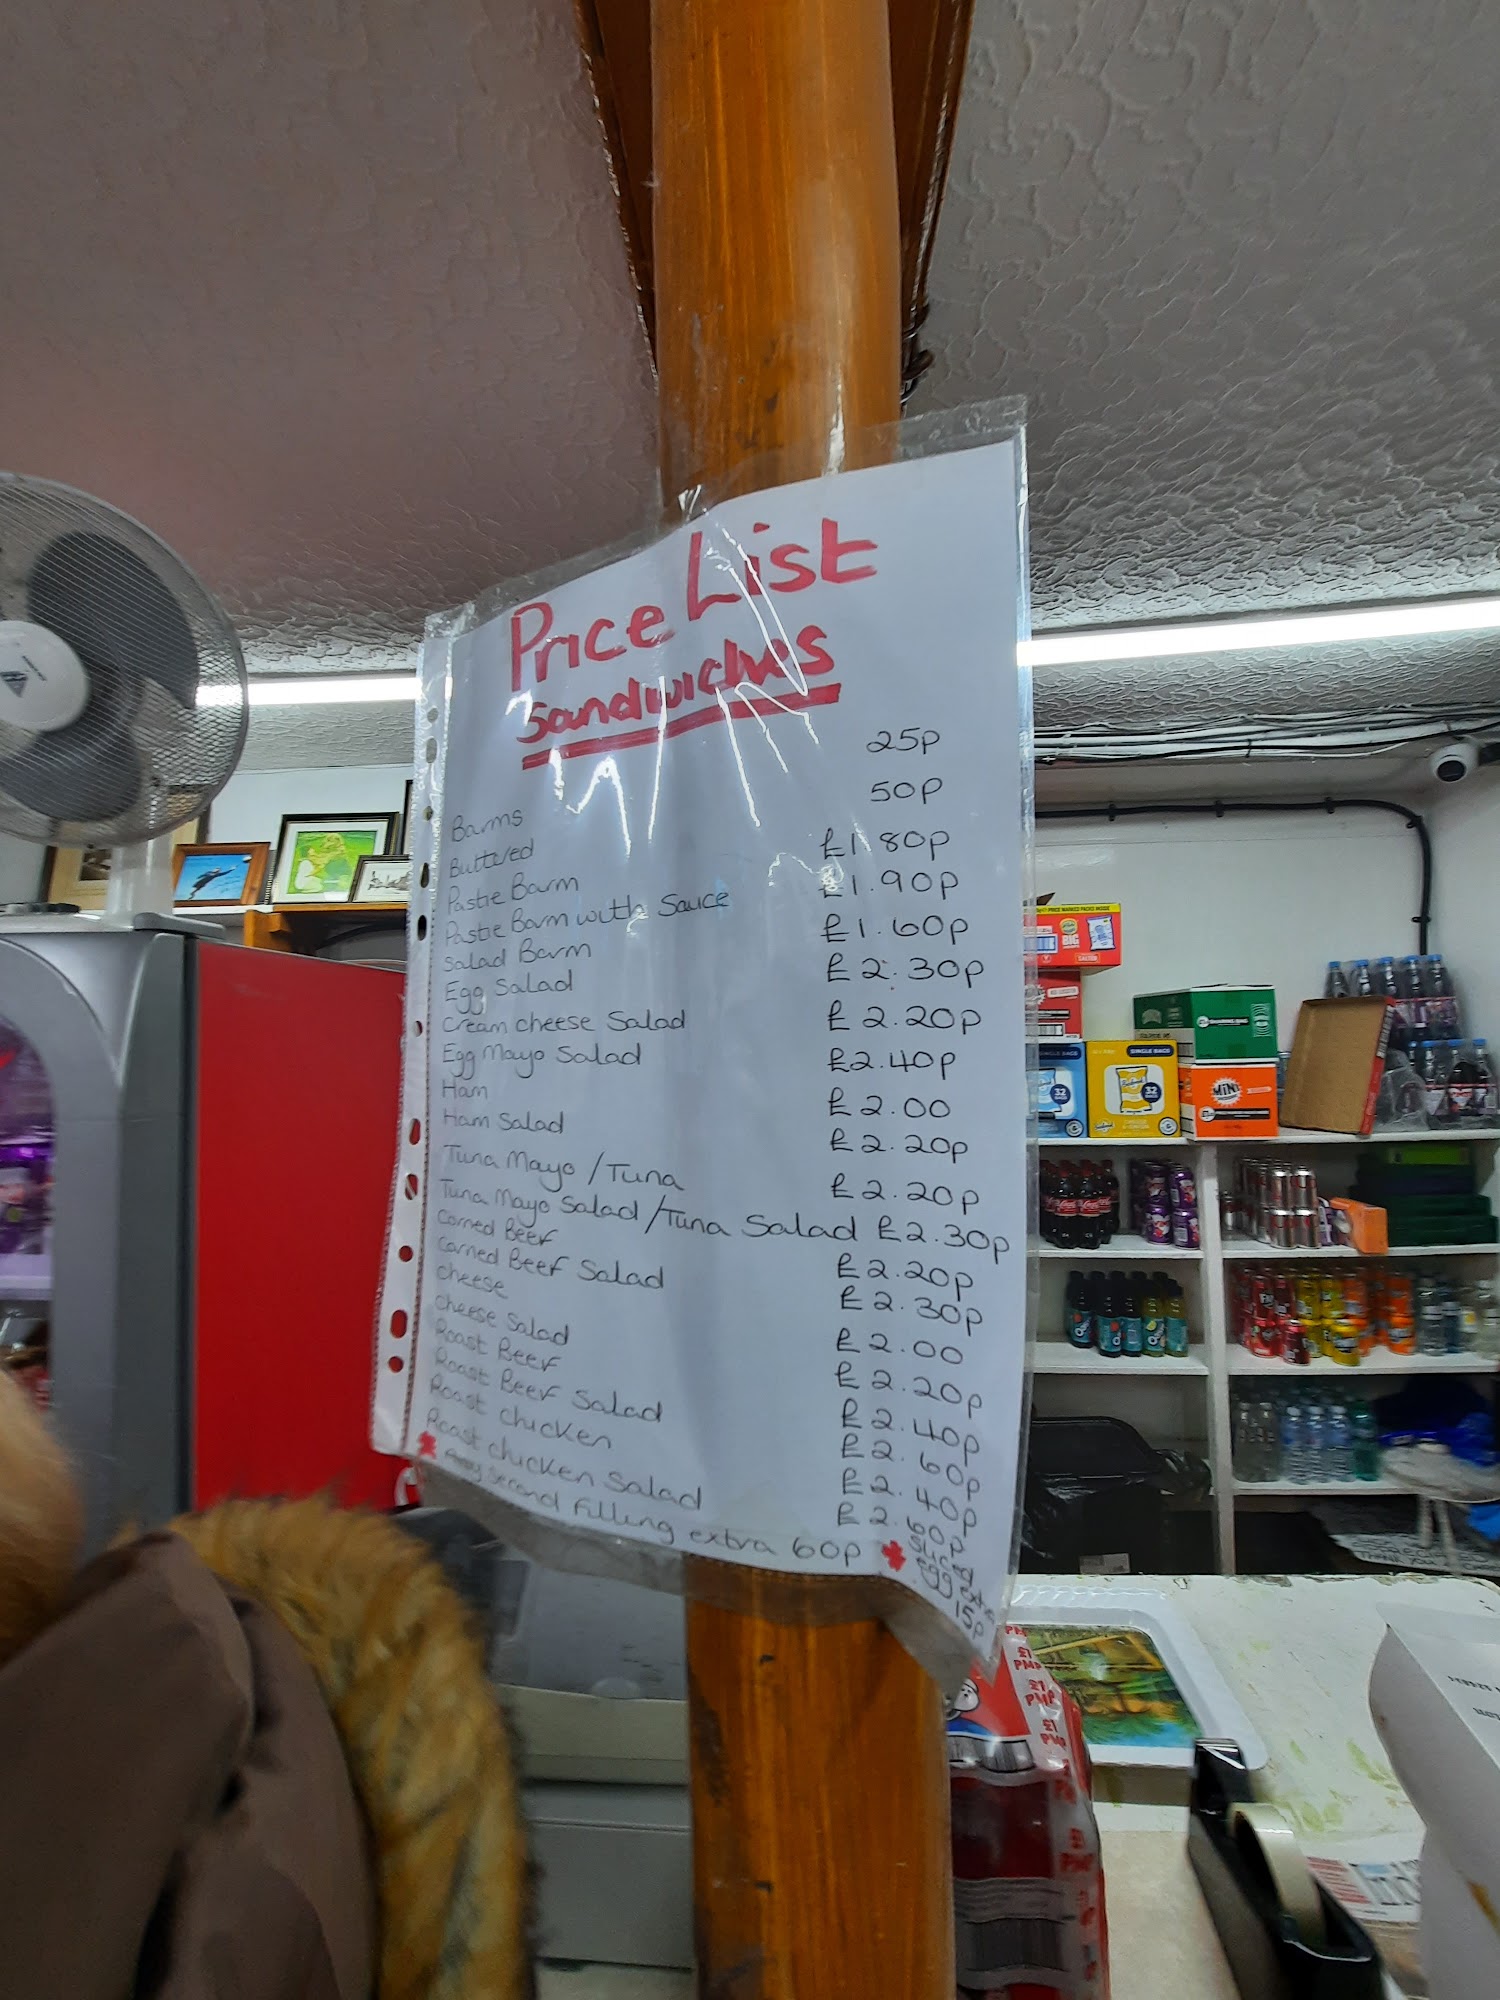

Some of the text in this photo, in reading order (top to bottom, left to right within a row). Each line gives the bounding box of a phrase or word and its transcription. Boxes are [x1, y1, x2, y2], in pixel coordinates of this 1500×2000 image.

[510, 517, 878, 692] Price List
[866, 727, 941, 755] 25p
[870, 777, 943, 805] 50p
[451, 809, 524, 842] Barms
[449, 838, 535, 878] Buttered
[447, 872, 579, 915] Pastie Barm
[446, 891, 731, 947] Pastie Barm with Sauce
[519, 937, 592, 964] Barm
[445, 969, 573, 1015] Egg Salad
[442, 1016, 508, 1034] Cream
[607, 1009, 686, 1032] Salad
[442, 1042, 642, 1080] Egg Mayo Salad
[442, 1079, 489, 1099] Ham
[1054, 1087, 1067, 1096] 32
[1144, 1086, 1158, 1095] 32
[443, 1107, 565, 1134] Ham Salad
[443, 1144, 500, 1169] Tuna
[506, 1150, 576, 1193] Mayo
[437, 1208, 559, 1246] Corned Beef
[440, 1178, 488, 1205] Tuna
[496, 1188, 551, 1228] Mayo
[561, 1194, 639, 1221] Salad
[742, 1212, 858, 1242] Salad
[437, 1236, 664, 1289] Corned Beef Salad
[435, 1318, 562, 1372] Roast Beef
[507, 1312, 570, 1346] Salad
[430, 1374, 488, 1415] Roast
[435, 1348, 663, 1422] Roast Beef Salad
[426, 1407, 482, 1451] Roast
[603, 1471, 702, 1510] Salad
[690, 1528, 777, 1556] extra
[792, 1536, 861, 1567] 60p
